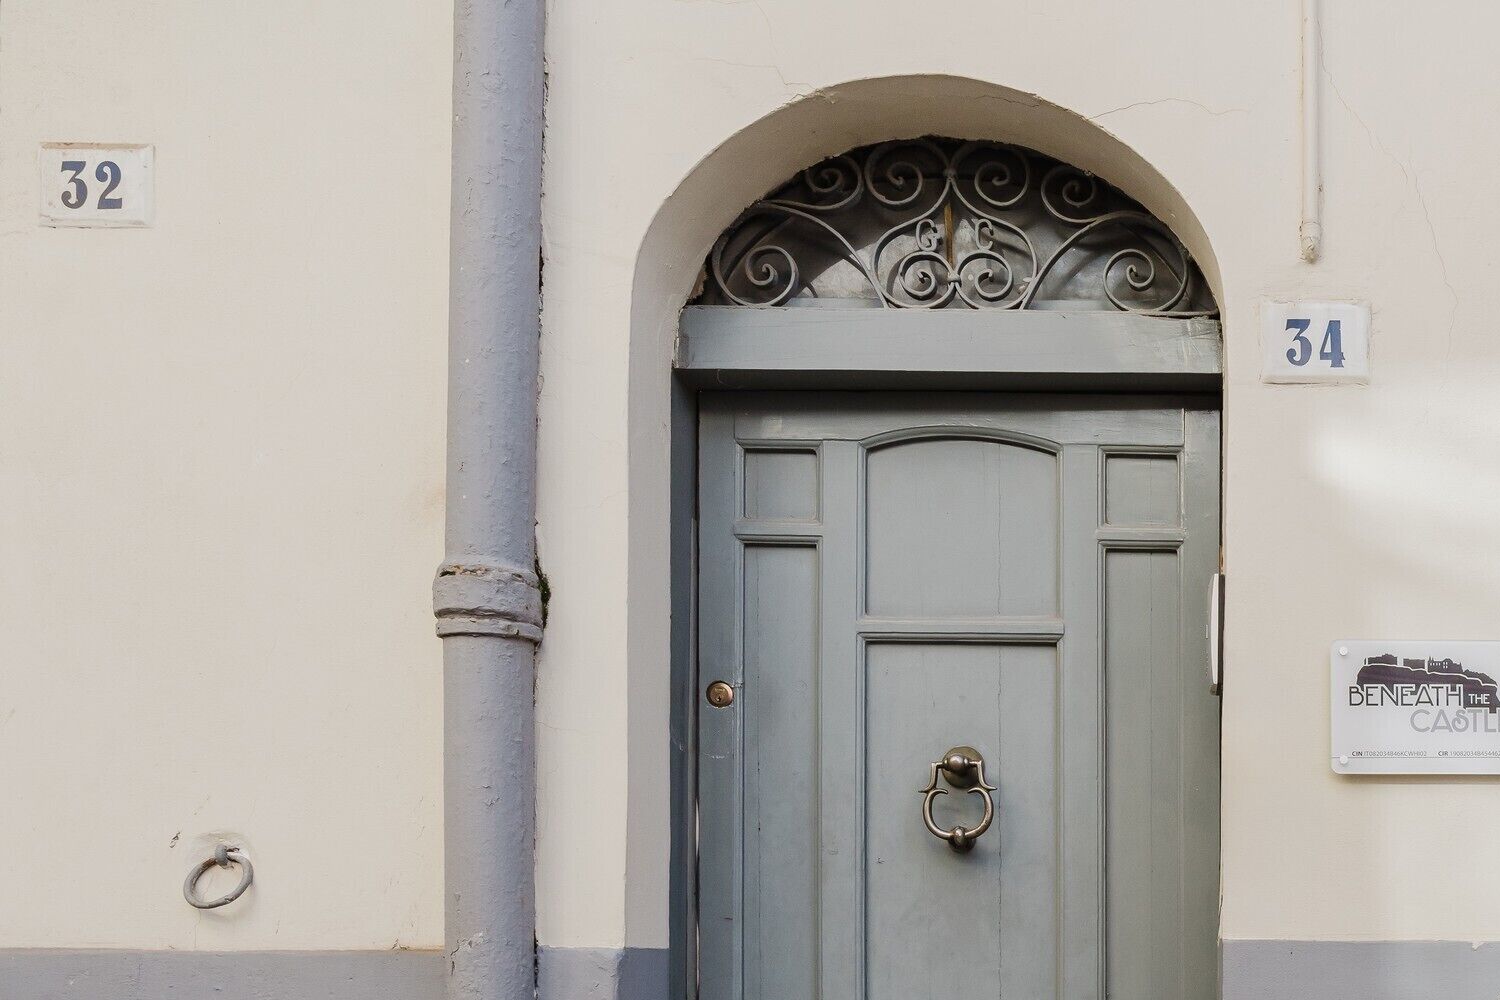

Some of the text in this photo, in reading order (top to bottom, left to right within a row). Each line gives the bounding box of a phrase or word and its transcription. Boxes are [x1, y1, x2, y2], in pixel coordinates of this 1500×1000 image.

[61, 160, 123, 210] 32
[1285, 318, 1346, 368] 34
[1349, 685, 1490, 707] BENEATH THE
